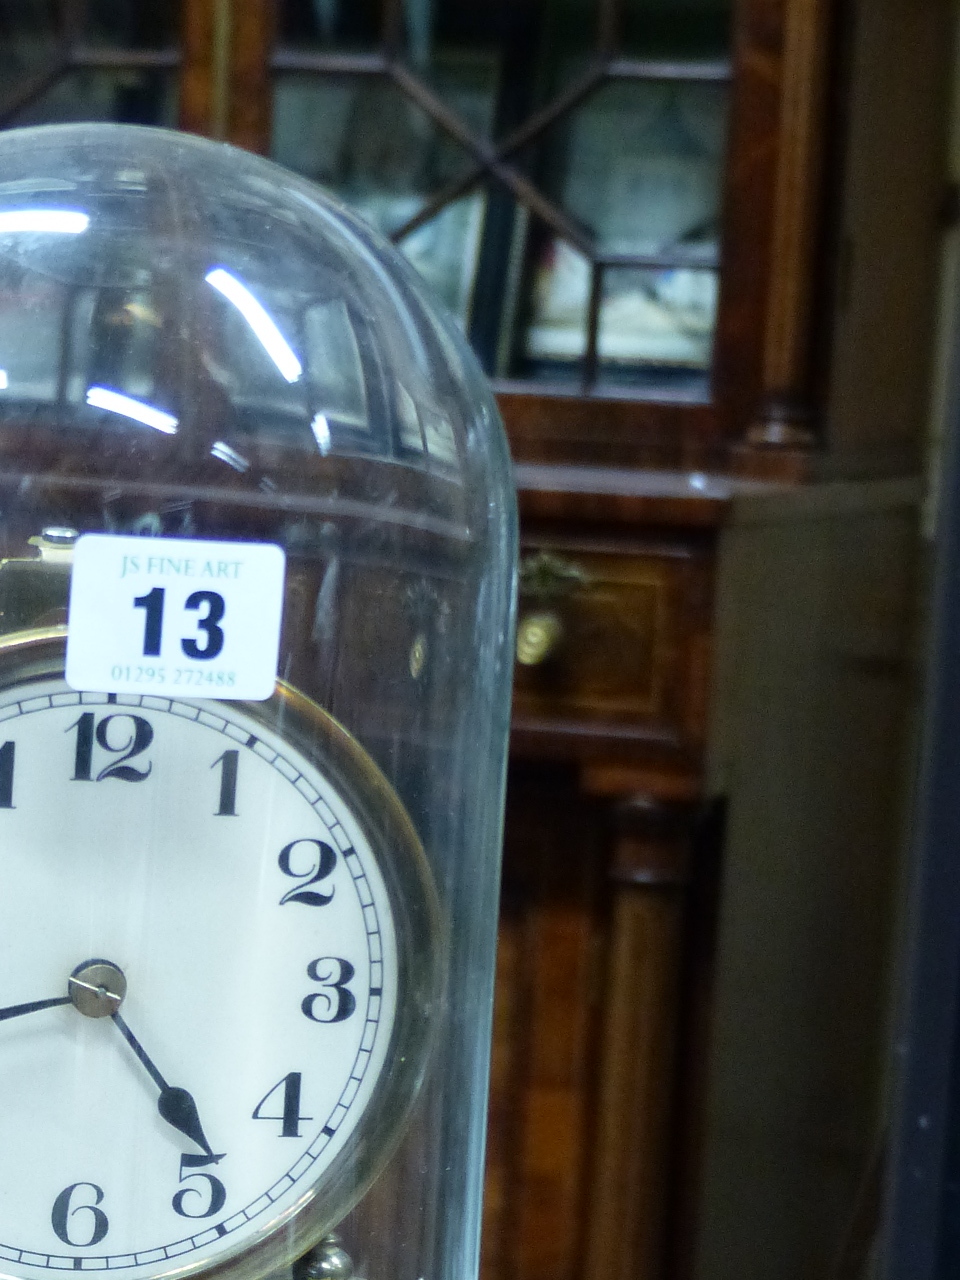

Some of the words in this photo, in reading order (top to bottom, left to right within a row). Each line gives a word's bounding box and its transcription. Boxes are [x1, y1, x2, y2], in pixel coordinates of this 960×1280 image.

[120, 556, 139, 579] JS
[147, 556, 196, 577] FINE
[201, 559, 243, 579] ART
[133, 587, 225, 661] 13
[111, 665, 166, 684] 01295
[173, 668, 236, 687] 272488
[64, 711, 154, 783] 12
[211, 750, 240, 816] 1
[277, 838, 338, 907] 2
[301, 956, 357, 1024] 3
[251, 1072, 314, 1138] 4
[50, 1182, 110, 1248] 6
[172, 1153, 228, 1219] 5
